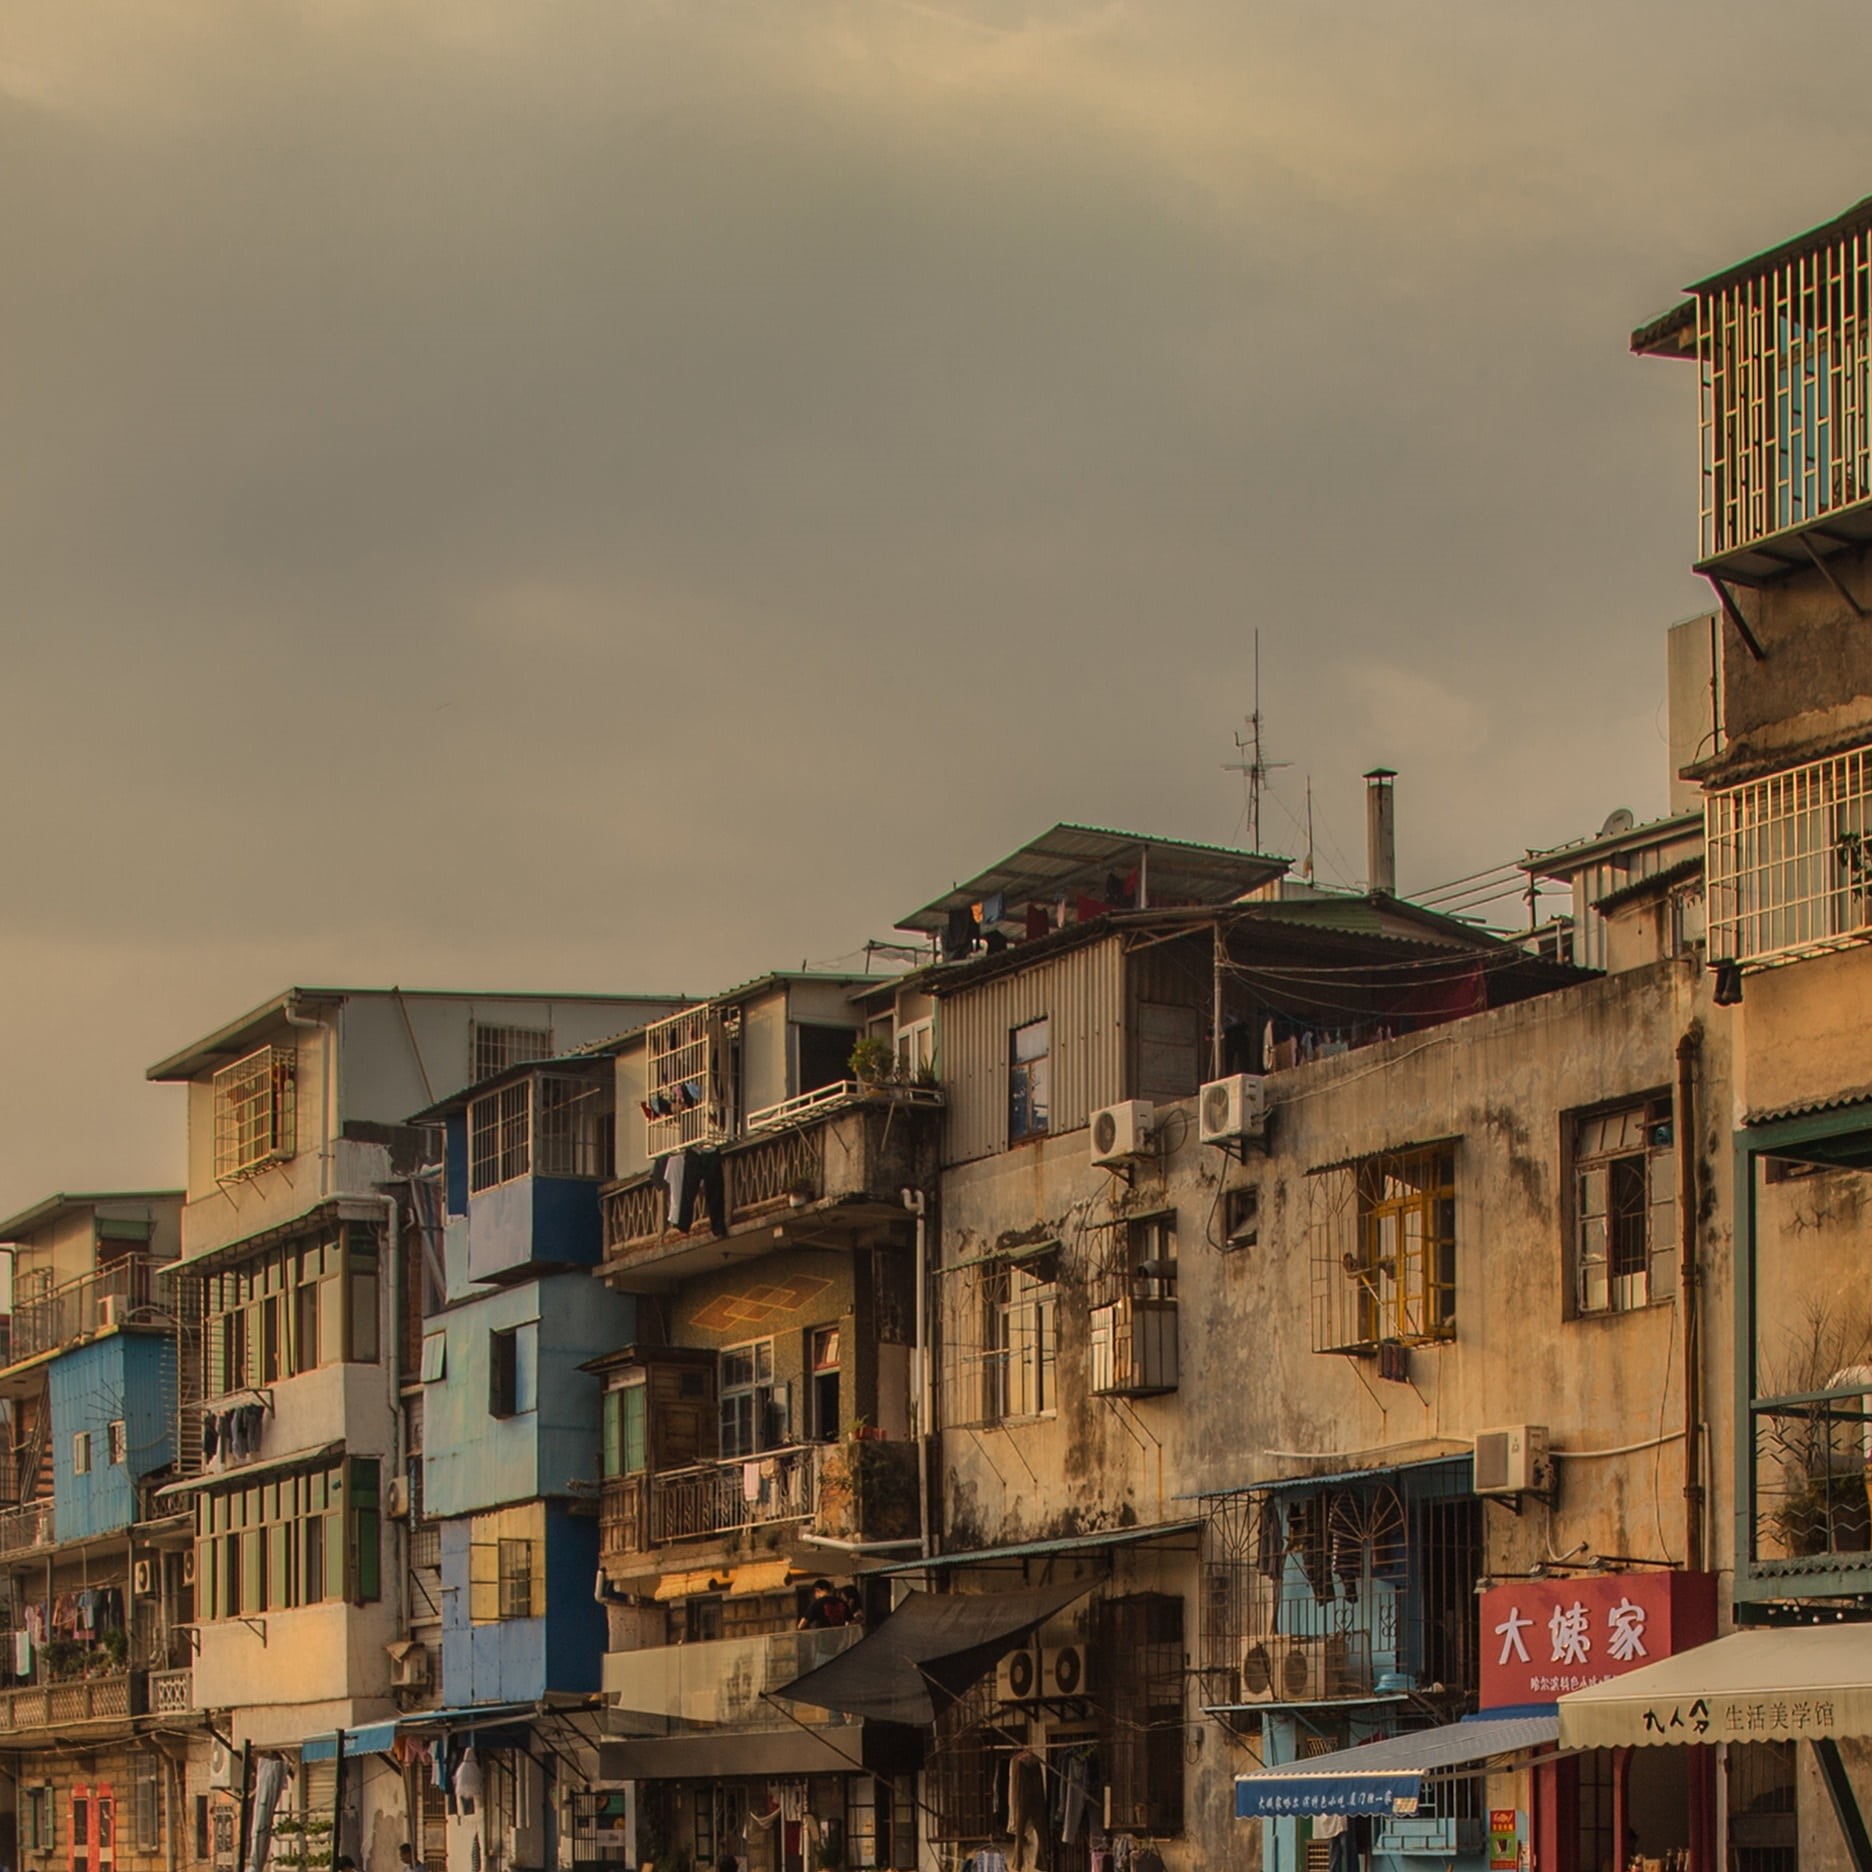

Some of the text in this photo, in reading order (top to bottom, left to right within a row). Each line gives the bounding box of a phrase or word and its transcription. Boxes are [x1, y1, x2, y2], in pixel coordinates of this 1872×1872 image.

[1494, 1596, 1648, 1666] 大姨家
[1725, 1701, 1834, 1732] 生活美学馆
